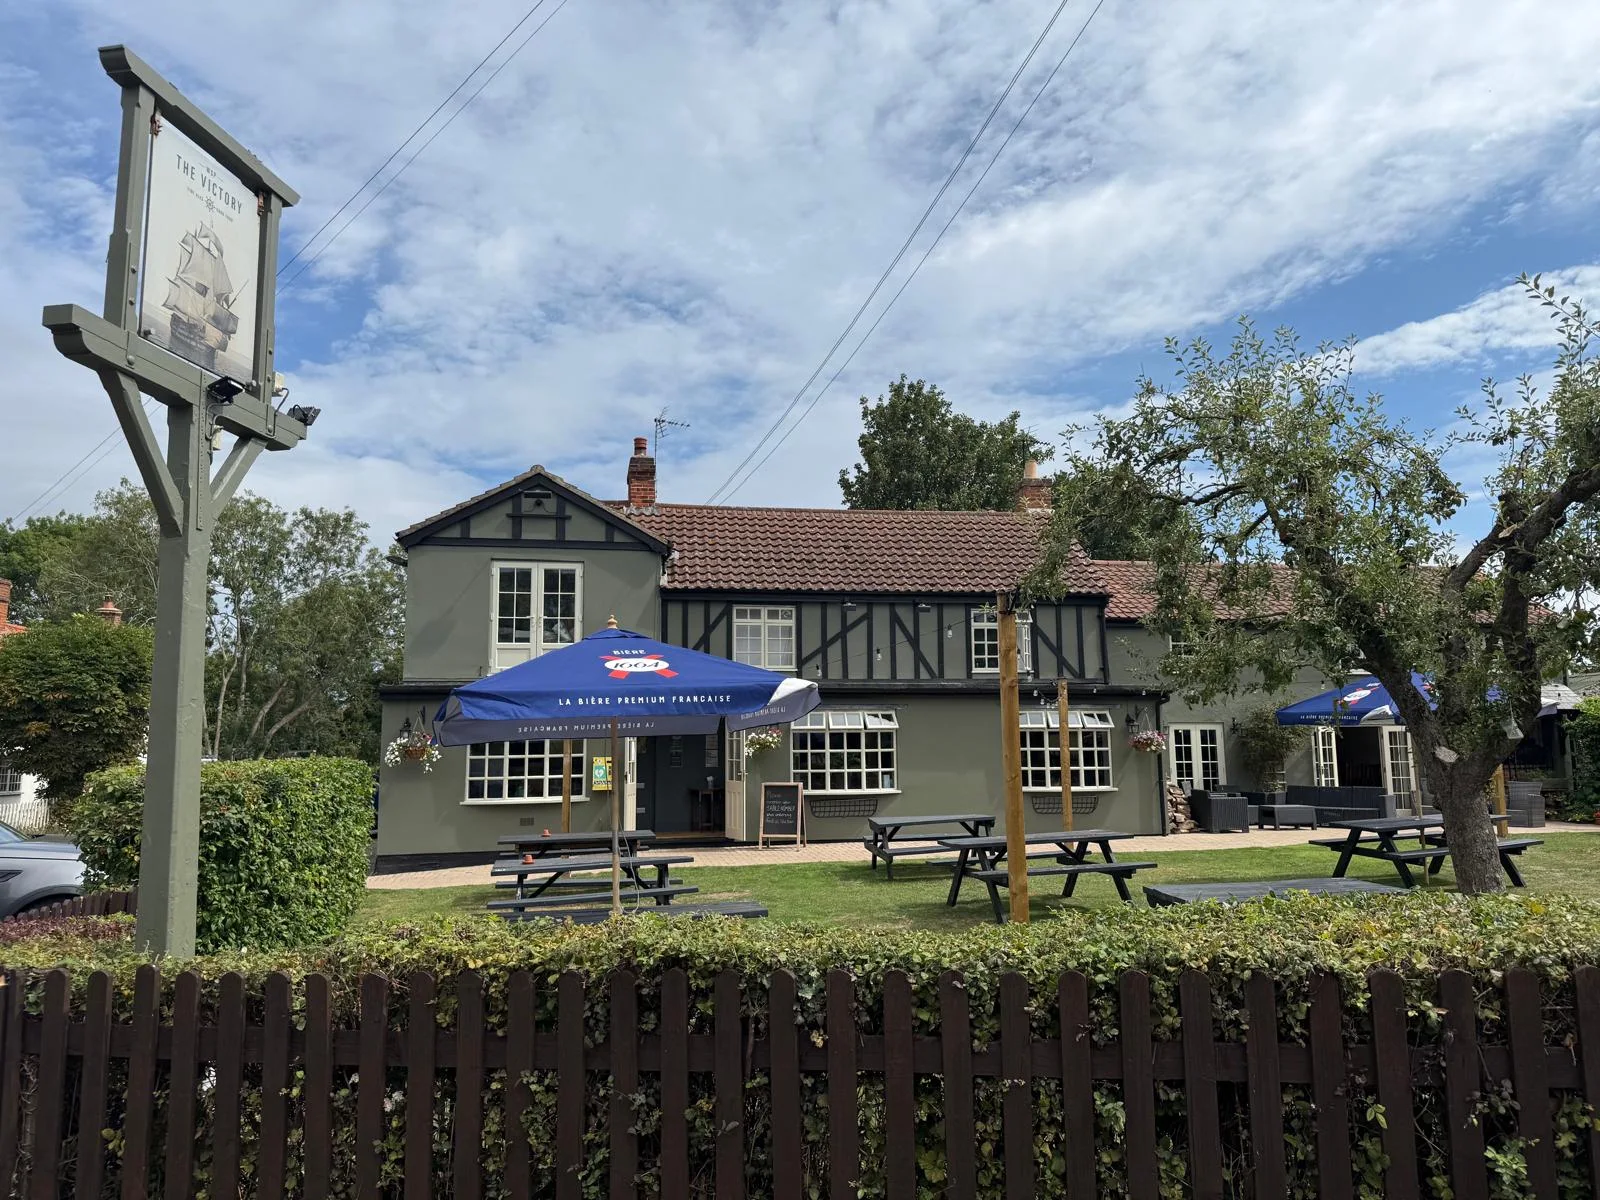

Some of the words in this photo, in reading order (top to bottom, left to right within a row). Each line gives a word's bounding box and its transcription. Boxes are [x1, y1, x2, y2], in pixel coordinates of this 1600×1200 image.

[176, 154, 196, 181] THE
[201, 173, 242, 214] VICTORY
[558, 698, 571, 706] LA
[578, 696, 610, 705] BIÈRE
[617, 696, 665, 704] PREMIUM
